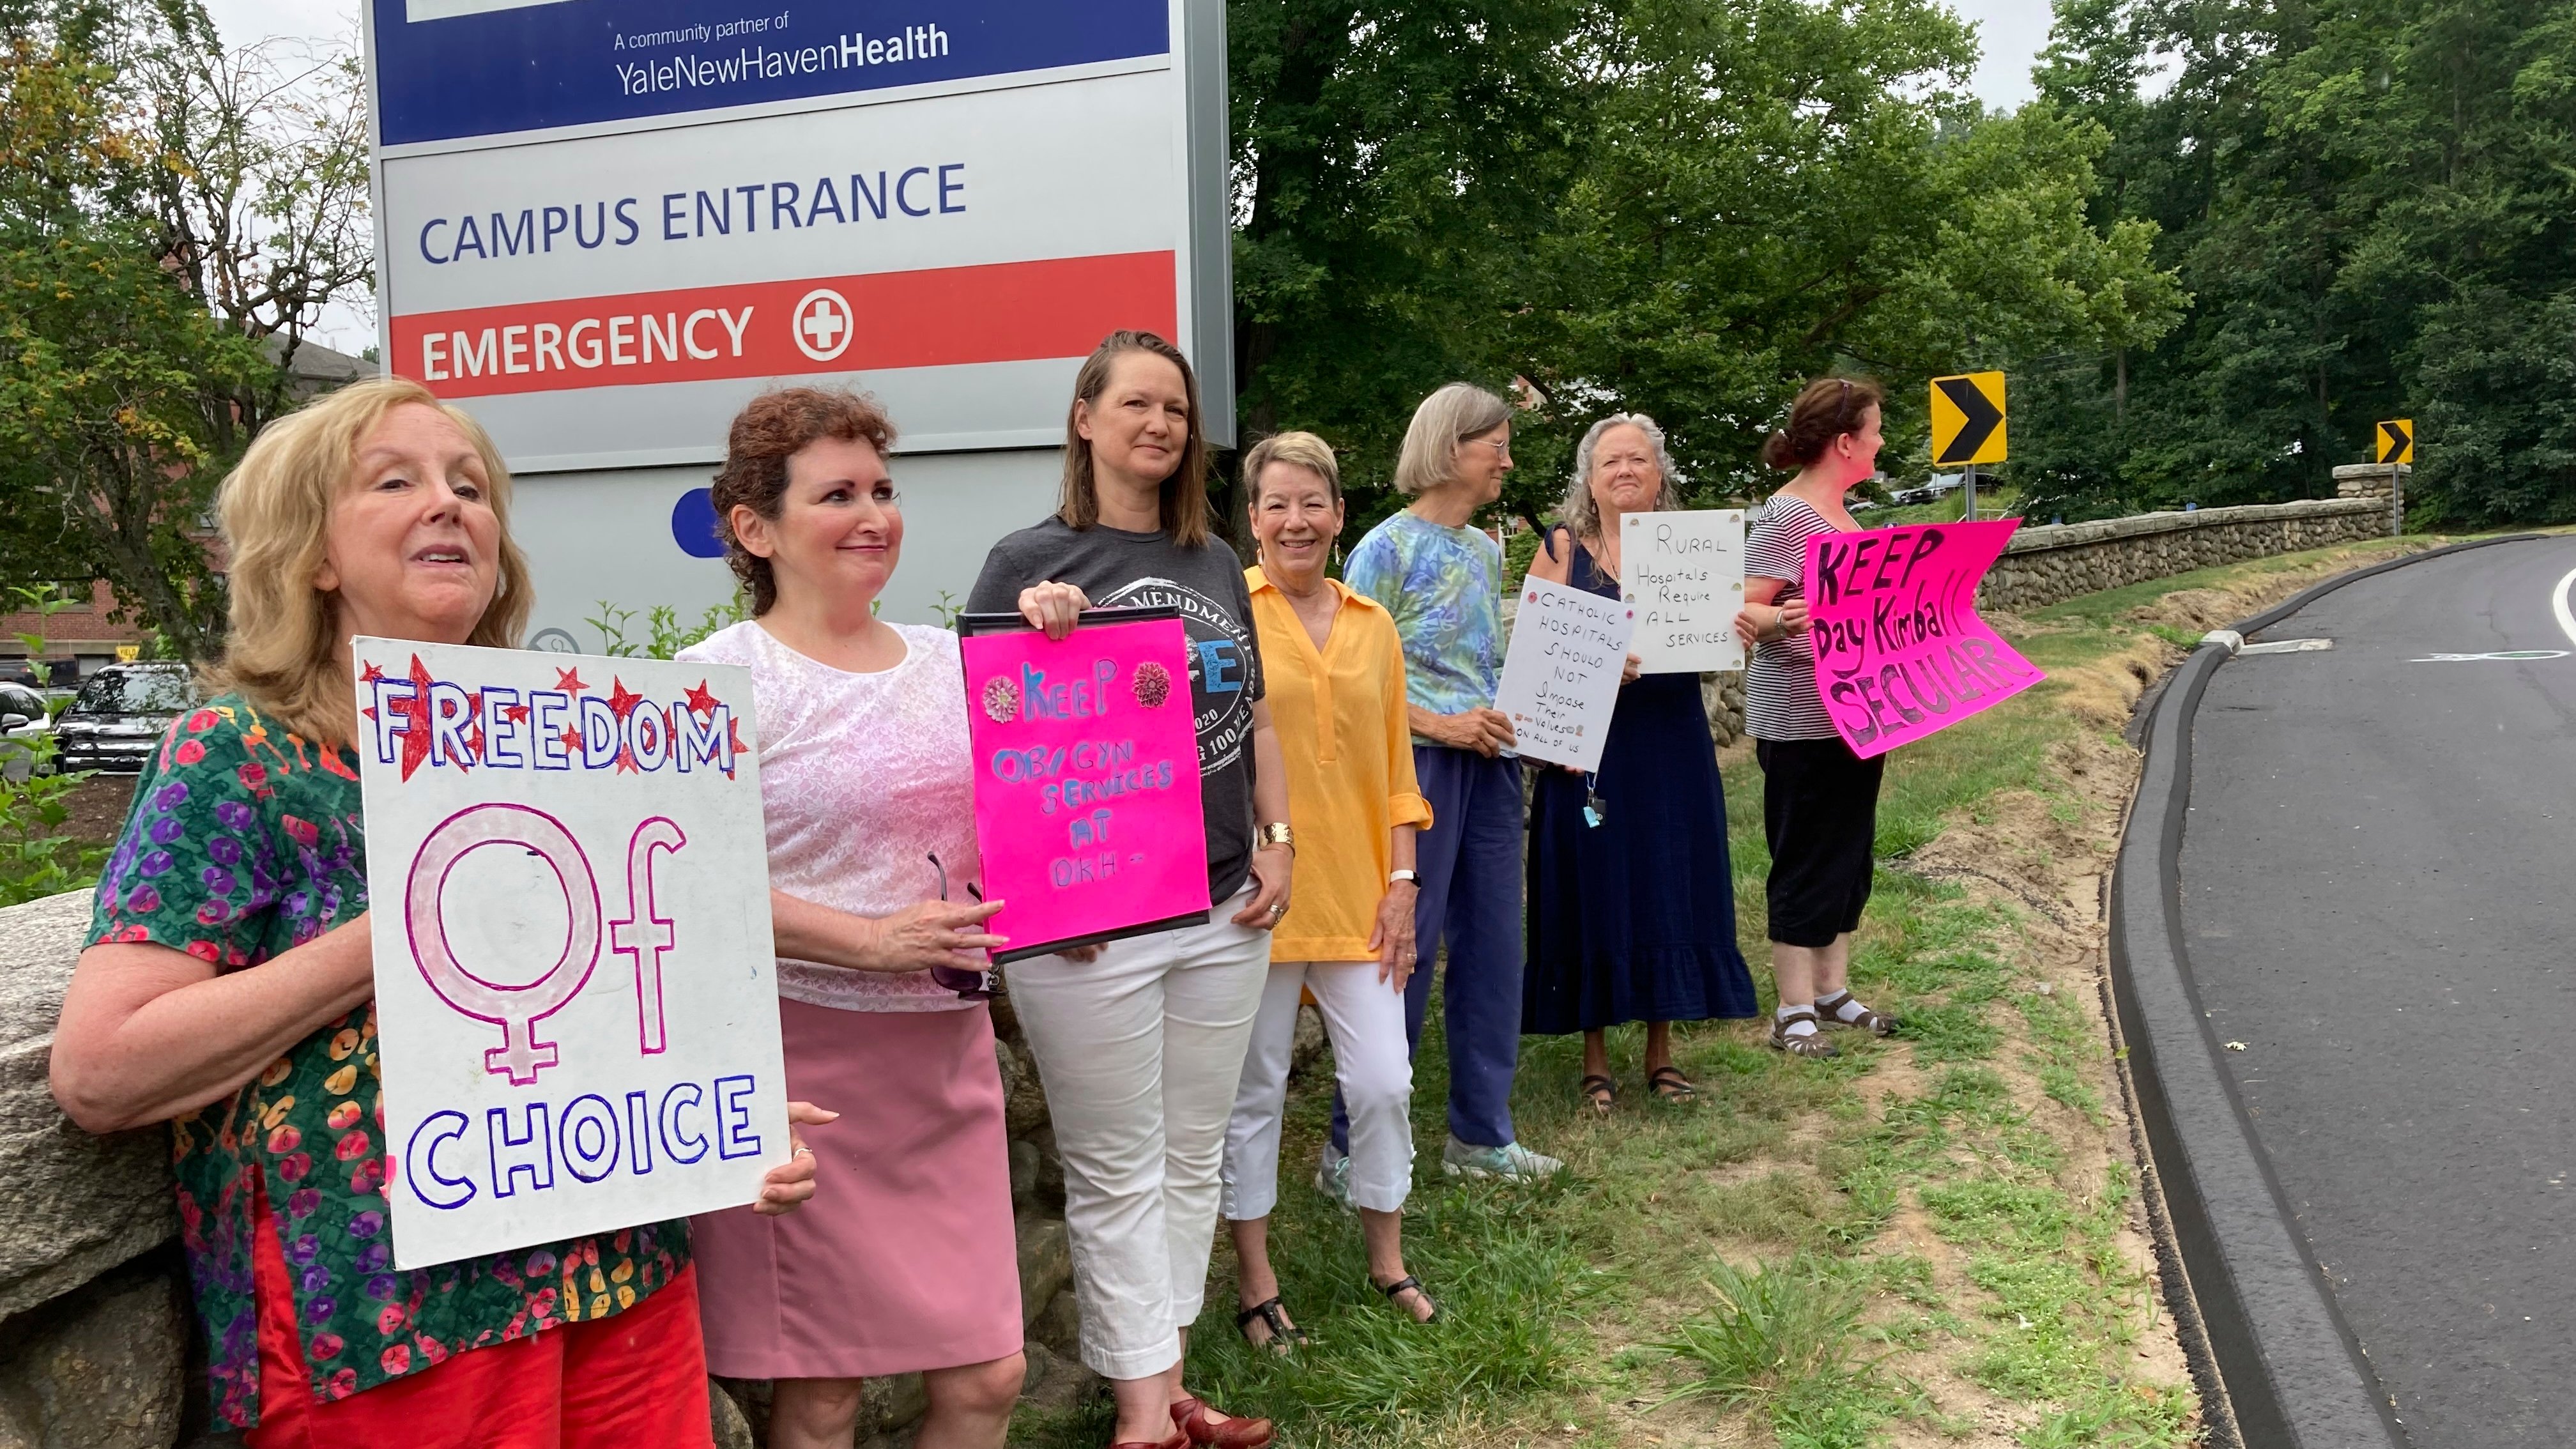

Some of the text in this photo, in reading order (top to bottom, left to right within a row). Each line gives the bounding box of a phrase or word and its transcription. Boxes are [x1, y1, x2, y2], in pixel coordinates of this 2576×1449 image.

[614, 10, 789, 50] A community partner of
[616, 23, 949, 96] YaleNewHavenHealth
[420, 163, 966, 264] CAMPUS ENTRANCE
[422, 306, 755, 381] EMERGENCY
[1657, 524, 1728, 555] RURAL
[1637, 563, 1708, 586] Hospitals
[1817, 528, 1945, 606] KEEP
[1541, 592, 1615, 625] CATHOLIC
[1659, 585, 1710, 606] Require
[1539, 615, 1623, 650] HOSPITALS
[1646, 611, 1690, 626] ALL
[1666, 632, 1728, 647] SERVICES
[1023, 658, 1117, 722] KEEP
[1554, 666, 1588, 684] NOT
[1536, 681, 1584, 710] Impose
[1829, 638, 2034, 747] SECULAR
[376, 676, 736, 774] FREEDOM
[1194, 709, 1218, 730] 020
[1536, 702, 1565, 719] Their
[1209, 728, 1237, 756] 100
[1516, 728, 1529, 739] ON
[1533, 733, 1548, 744] ALL
[1569, 744, 1579, 753] US
[1041, 762, 1174, 815] SERVICES
[1071, 809, 1112, 848] AT
[406, 1075, 762, 1210] CHOICE
